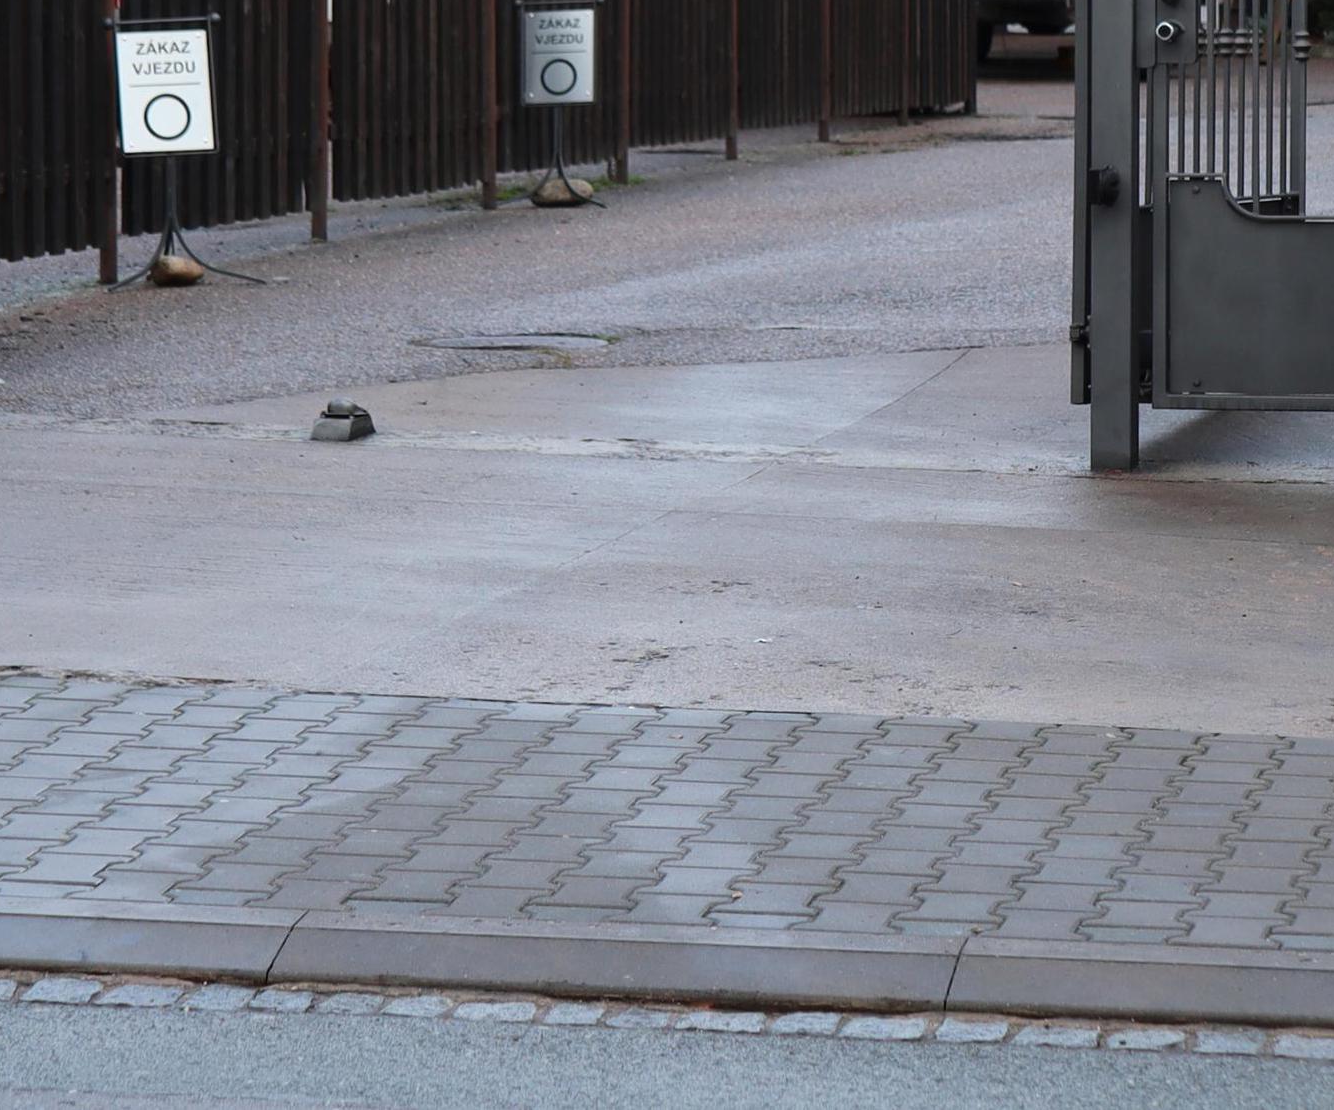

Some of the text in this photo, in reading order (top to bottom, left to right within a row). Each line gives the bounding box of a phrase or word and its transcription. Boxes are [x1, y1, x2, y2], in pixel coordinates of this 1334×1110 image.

[535, 34, 584, 45] VJEZDU
[136, 39, 190, 55] ZÁKAZ
[132, 61, 195, 75] VJEZDU
